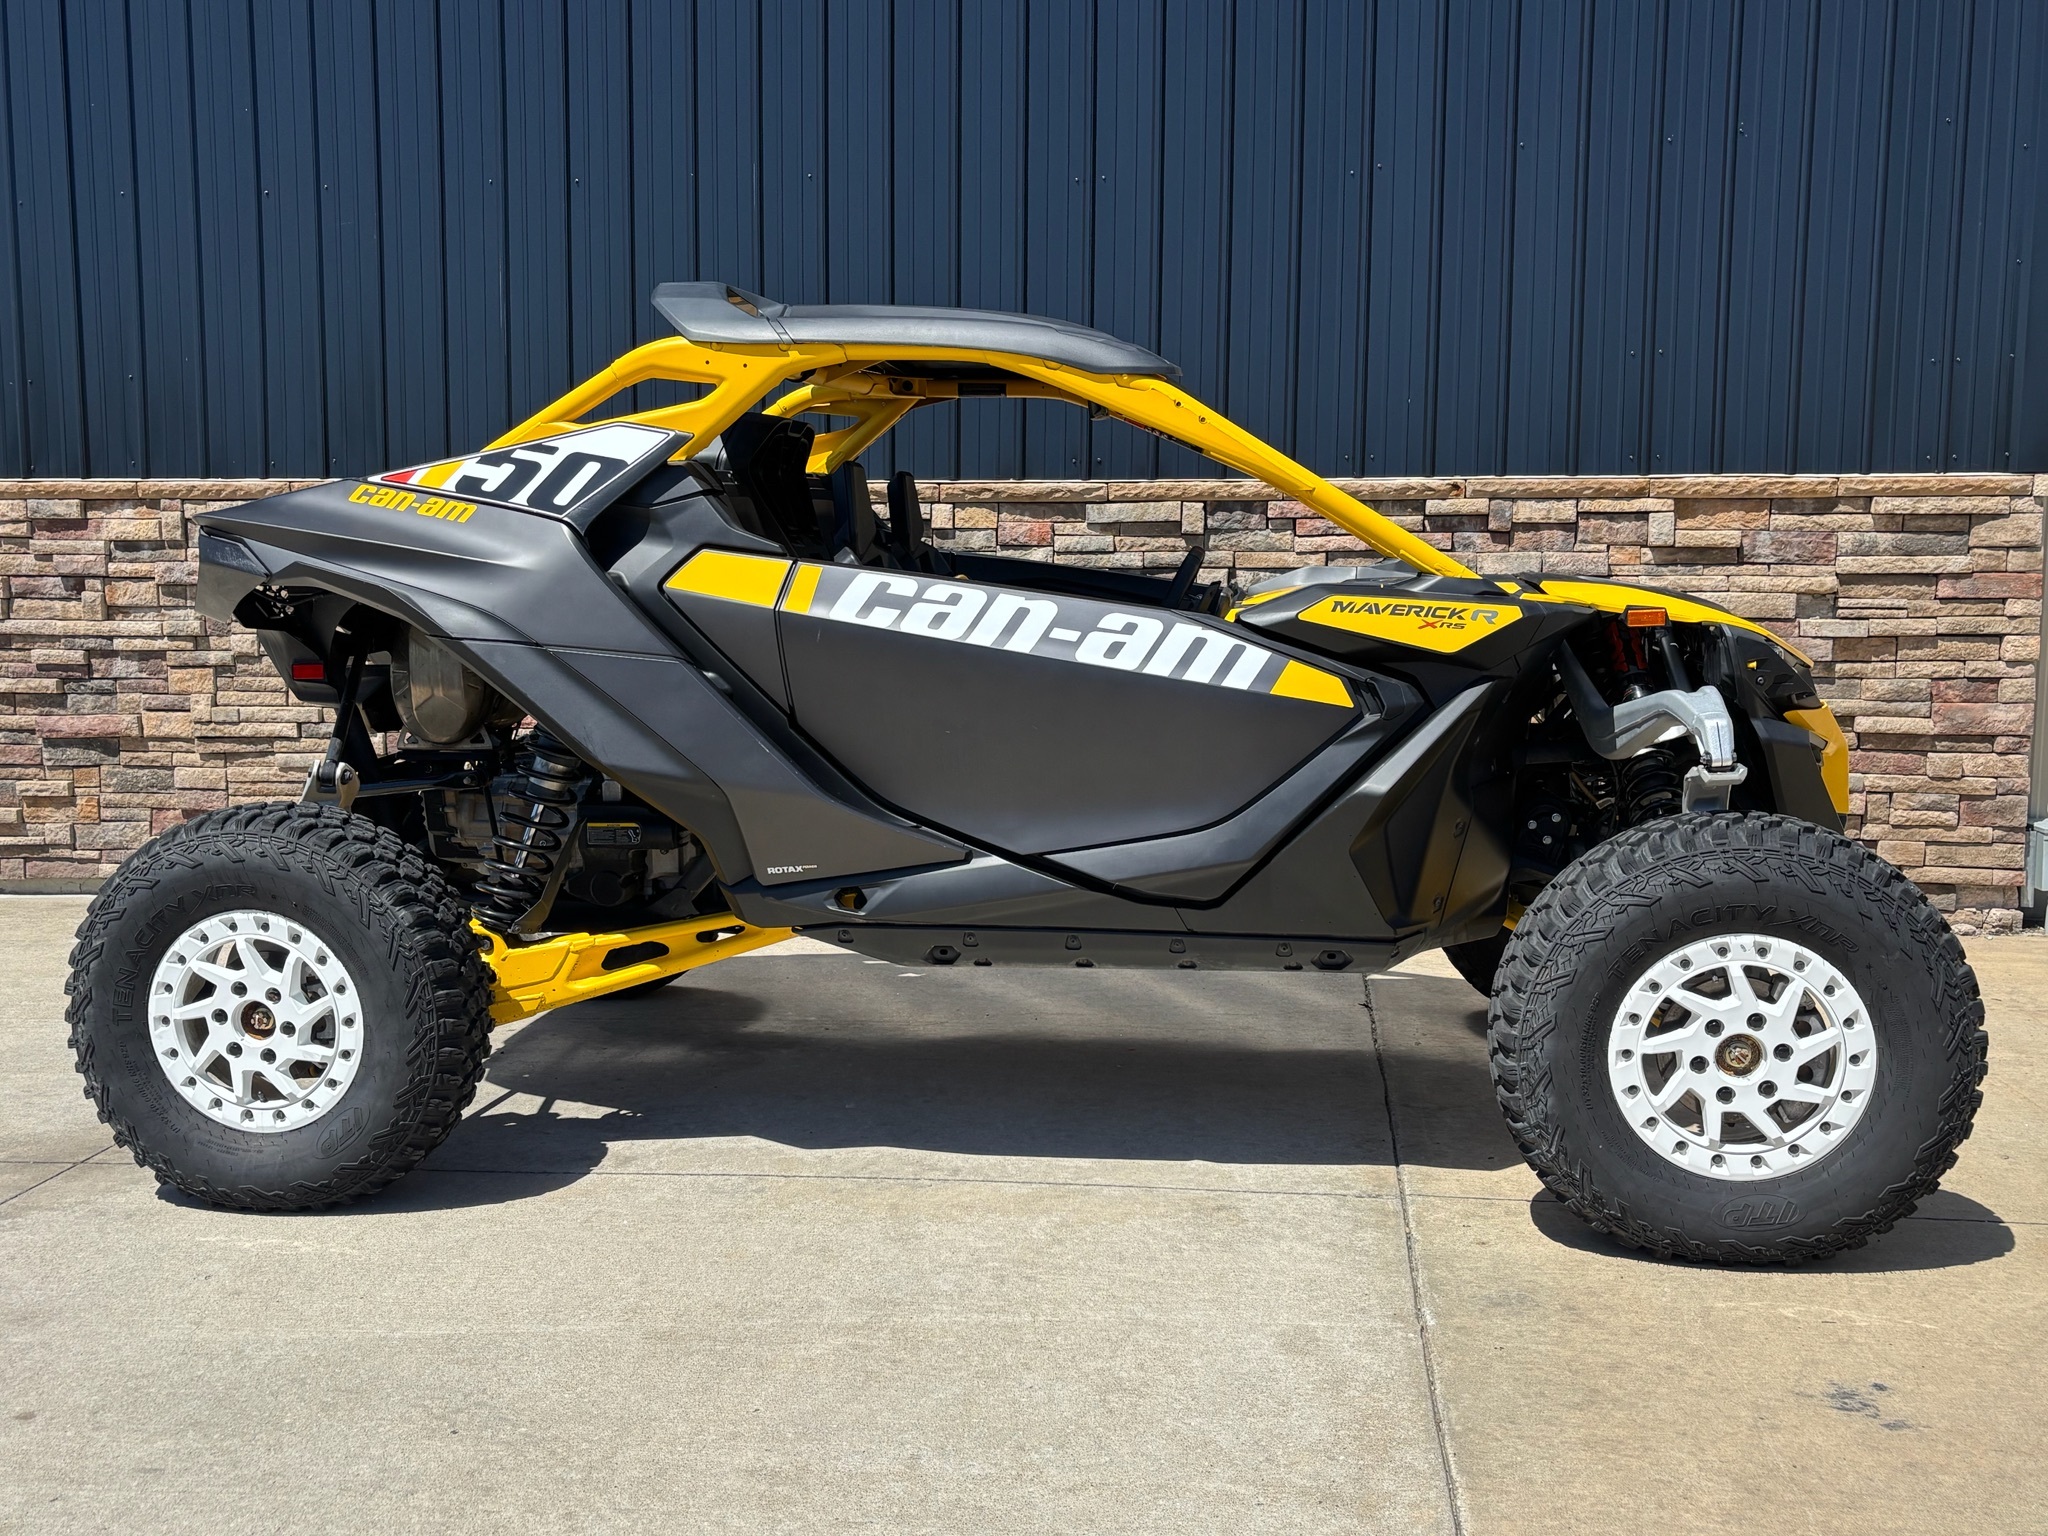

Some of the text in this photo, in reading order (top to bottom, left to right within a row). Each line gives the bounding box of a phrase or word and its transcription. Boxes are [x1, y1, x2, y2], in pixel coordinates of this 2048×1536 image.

[455, 443, 630, 510] 50
[348, 484, 478, 524] can-am
[829, 572, 1273, 691] can-am
[1330, 600, 1500, 625] MAVERICK R
[1417, 619, 1467, 630] XRS
[766, 865, 803, 874] ROTAX
[112, 895, 185, 1027] TENACITY
[1606, 903, 1778, 979] TENACITY
[1722, 1200, 1797, 1228] ITP
